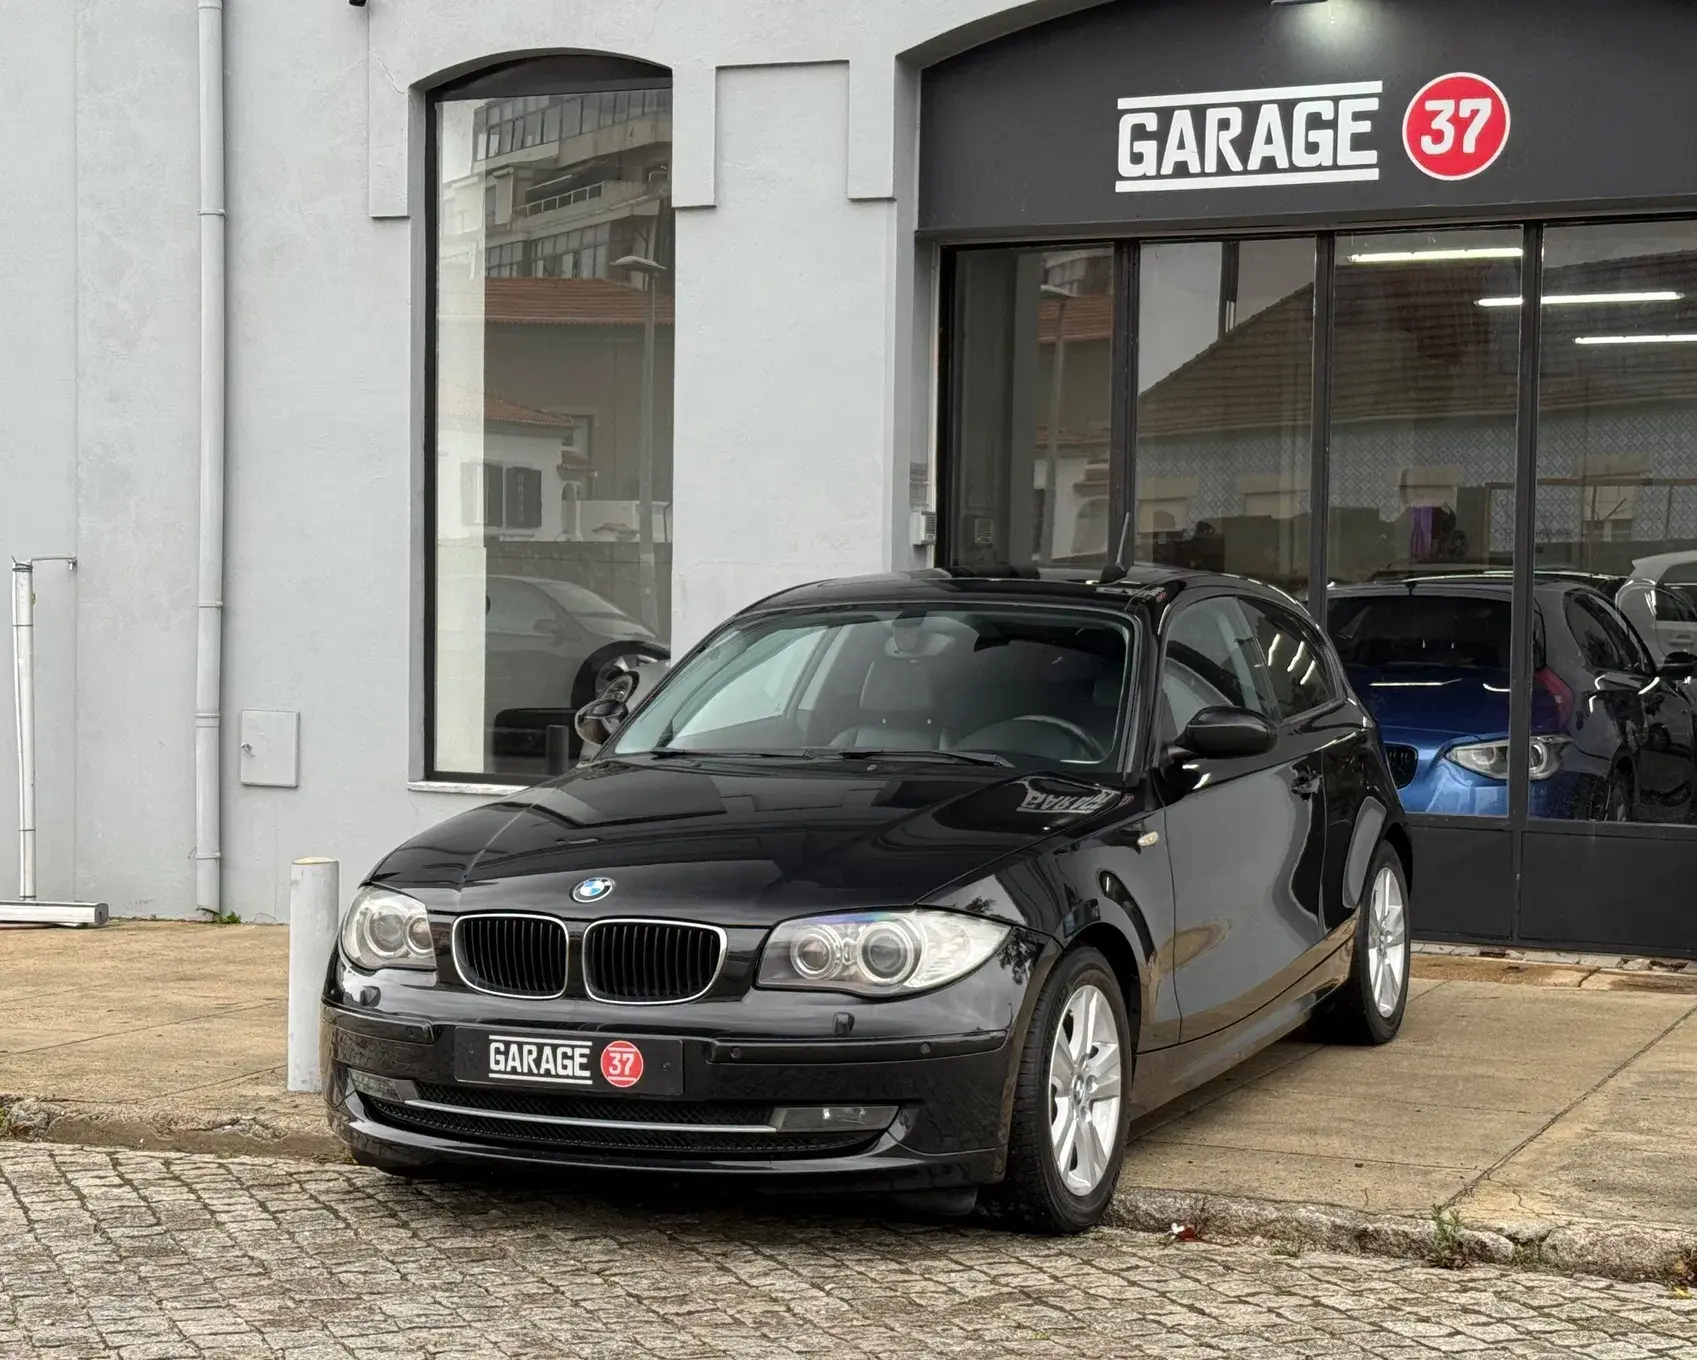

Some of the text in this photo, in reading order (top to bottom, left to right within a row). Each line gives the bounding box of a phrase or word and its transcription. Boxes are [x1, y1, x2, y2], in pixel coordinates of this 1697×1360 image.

[1117, 97, 1492, 178] GARAGE 37
[489, 1041, 635, 1078] GARAGE 37
